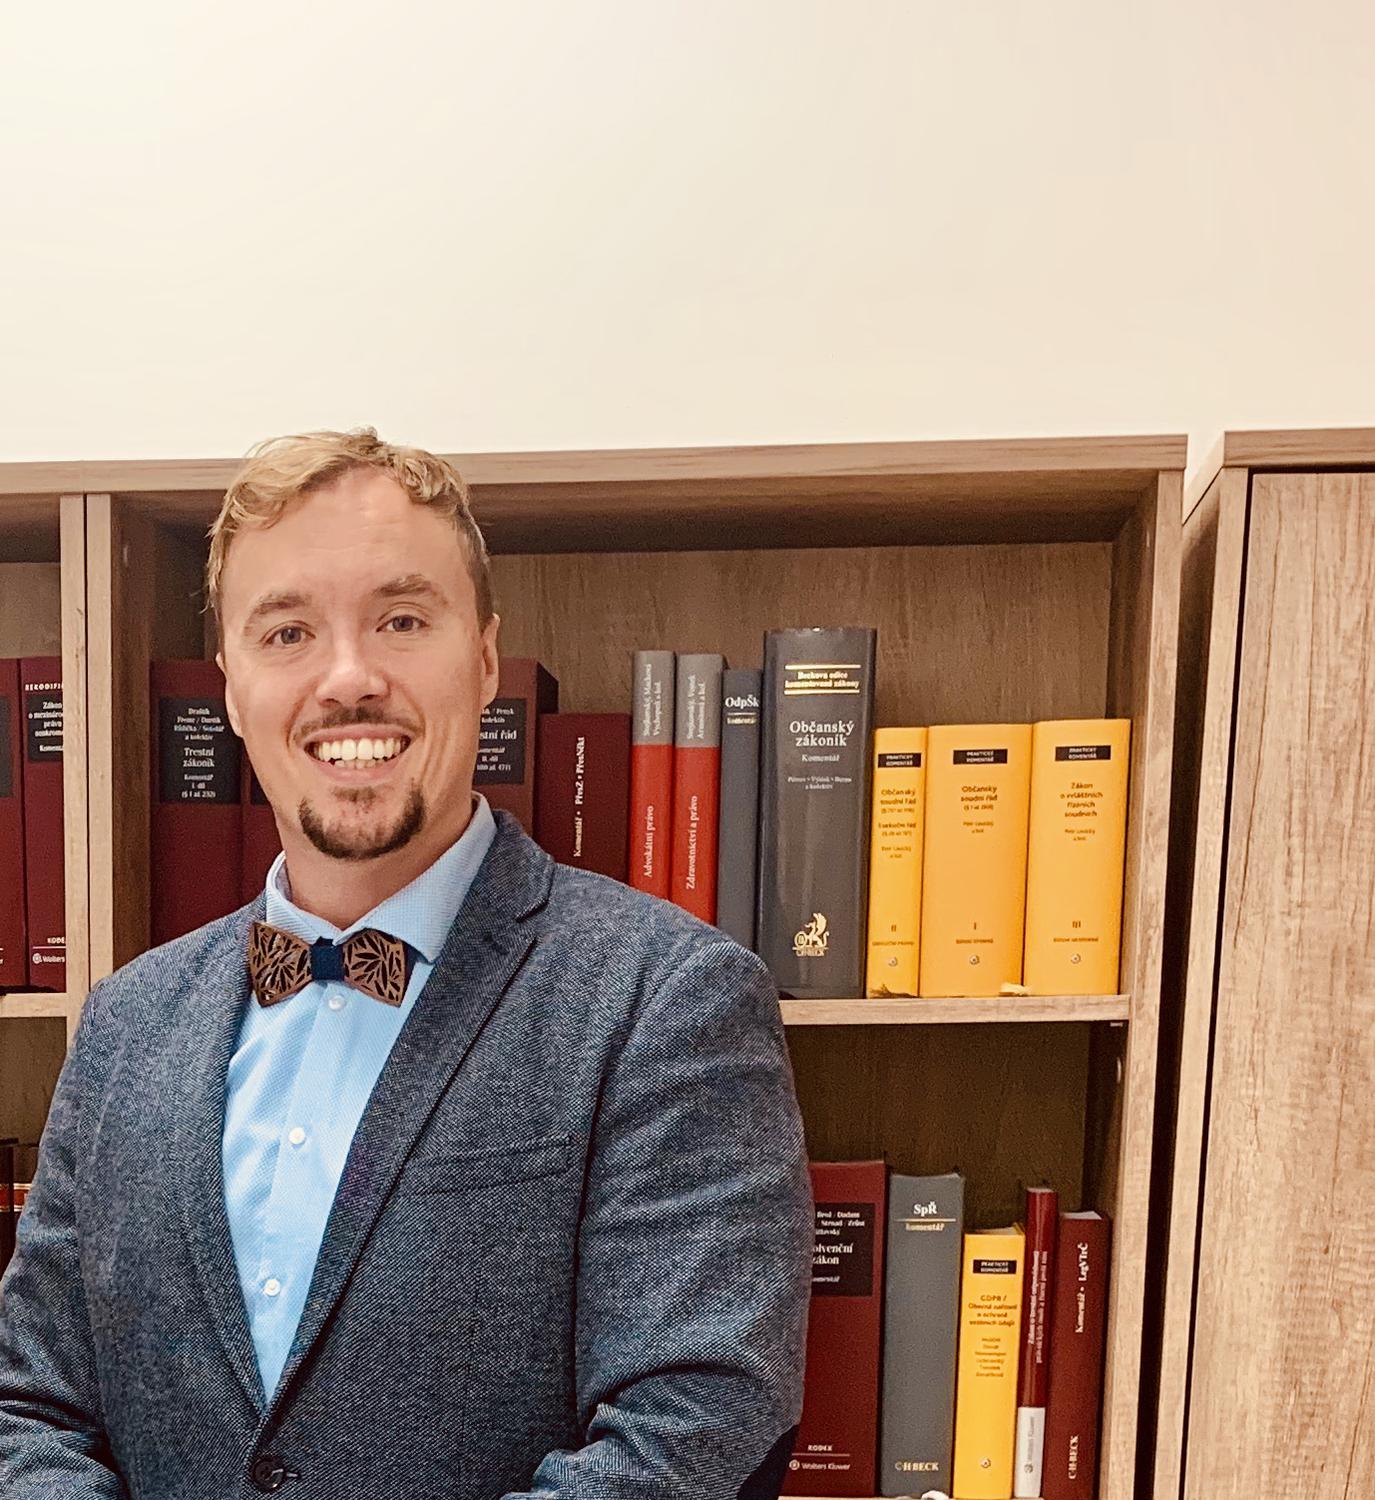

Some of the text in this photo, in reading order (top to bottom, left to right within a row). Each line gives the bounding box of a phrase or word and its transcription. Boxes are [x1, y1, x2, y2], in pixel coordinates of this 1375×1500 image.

[25, 683, 63, 692] REKODIFI
[725, 694, 759, 710] OdpŠk
[500, 730, 517, 739] řád
[789, 720, 854, 736] Občanský
[795, 734, 847, 747] zákoník
[184, 747, 214, 756] Trestní
[801, 754, 840, 762] Komentář
[183, 758, 215, 767] zákoník
[961, 785, 997, 793] Občanský
[688, 795, 700, 821] právo
[573, 817, 583, 858] Komentář
[643, 805, 656, 878] Advokátní právo
[686, 829, 697, 889] Zdravotnictví
[913, 1201, 937, 1217] SpŘ
[1075, 1293, 1086, 1333] Komentář
[801, 1462, 826, 1470] Wolters
